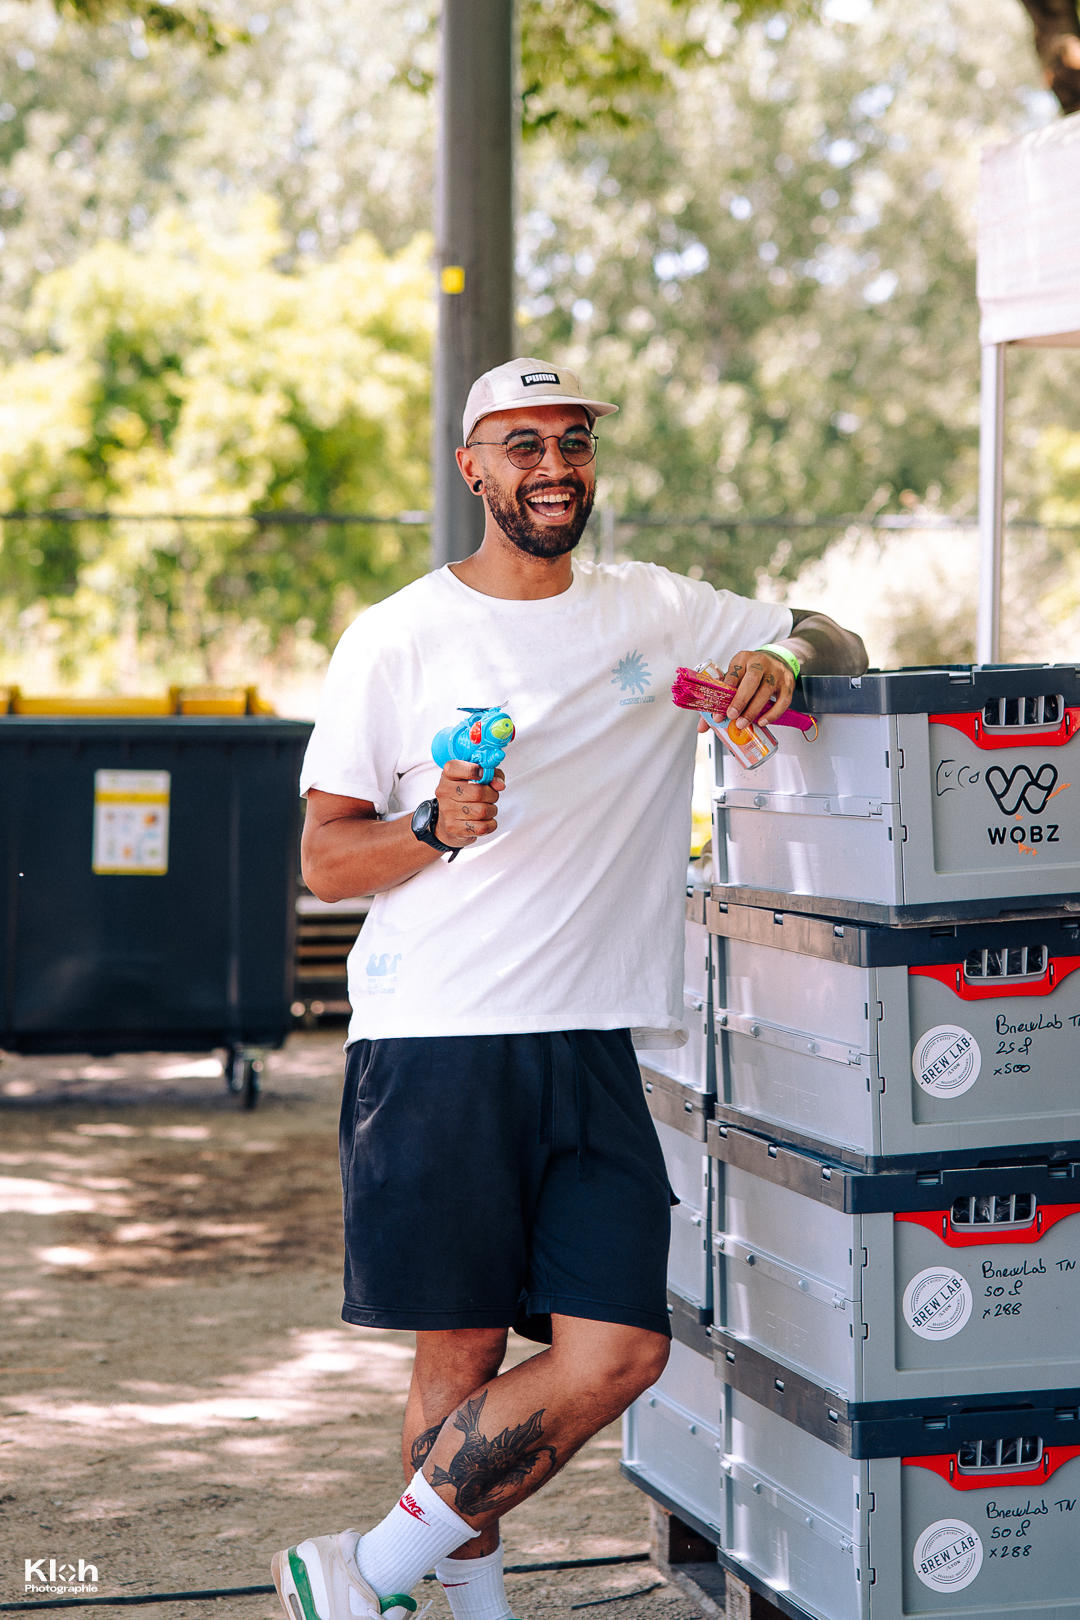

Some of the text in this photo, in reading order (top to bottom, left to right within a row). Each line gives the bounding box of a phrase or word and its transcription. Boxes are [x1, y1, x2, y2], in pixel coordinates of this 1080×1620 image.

[525, 374, 556, 383] PUMA
[988, 824, 1060, 845] WOBZ
[921, 1056, 951, 1085] BREW
[951, 1037, 971, 1059] LAB
[912, 1297, 941, 1328] BREW
[941, 1278, 962, 1301] LAB
[404, 1493, 426, 1516] NIKE
[920, 1554, 951, 1574] BREW
[953, 1536, 975, 1555] LAB
